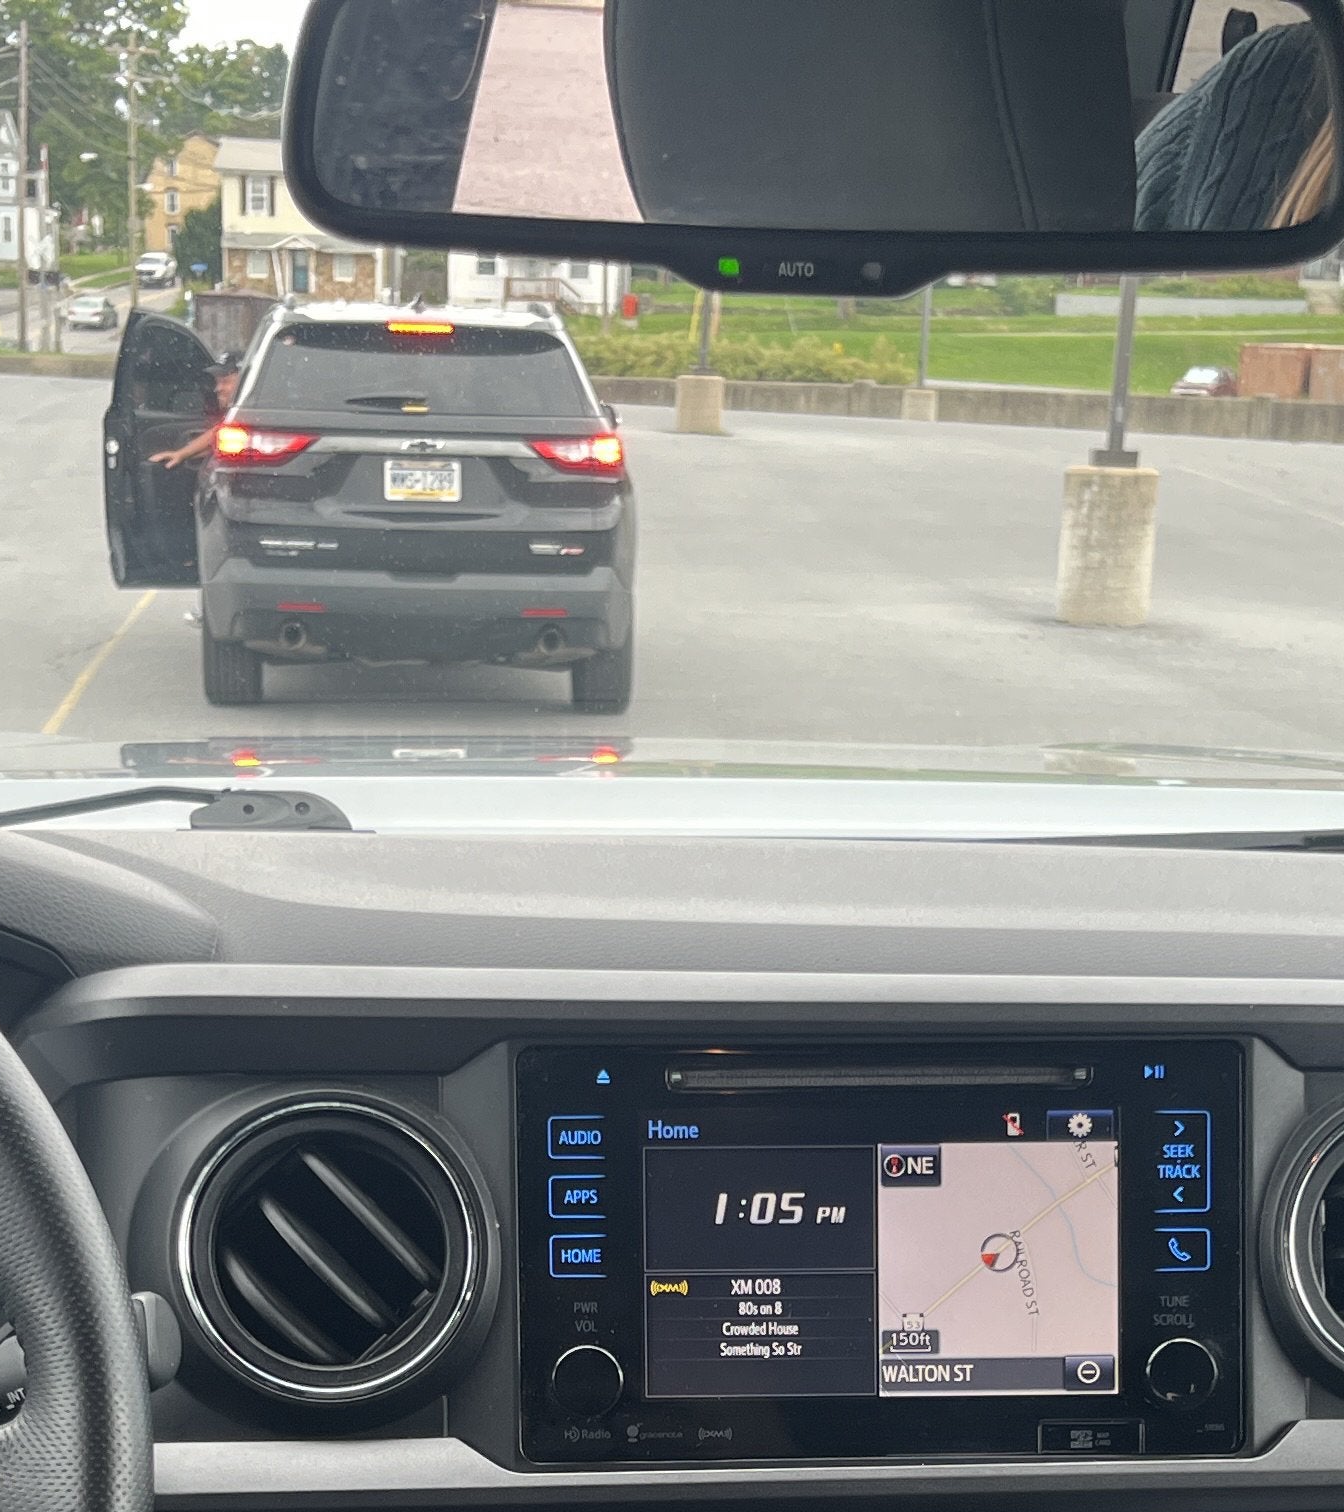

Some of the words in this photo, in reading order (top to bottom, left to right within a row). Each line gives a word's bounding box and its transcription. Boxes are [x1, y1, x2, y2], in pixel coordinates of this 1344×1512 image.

[778, 262, 814, 277] AUTO
[558, 1130, 602, 1145] AUDIO
[648, 1120, 700, 1140] Home
[1162, 1144, 1194, 1158] SEEK
[907, 1157, 934, 1174] NE
[1157, 1164, 1201, 1179] TRACK
[563, 1189, 598, 1204] APPS
[715, 1192, 806, 1225] 1:05
[815, 1206, 846, 1224] PM
[561, 1249, 602, 1264] HOME
[730, 1279, 753, 1295] XM
[755, 1278, 782, 1295] 008
[573, 1302, 598, 1313] PWR
[738, 1301, 757, 1315] 80s
[760, 1305, 772, 1315] on
[774, 1301, 782, 1315] 8
[1159, 1296, 1190, 1307] TUNE
[574, 1320, 598, 1333] VOL
[1153, 1314, 1194, 1326] SCROLL
[722, 1322, 766, 1336] Crowded
[768, 1322, 799, 1336] House
[891, 1332, 931, 1346] 150ft
[719, 1342, 770, 1358] Something
[772, 1342, 785, 1356] So
[787, 1342, 802, 1356] Str
[882, 1364, 950, 1382] WALTON
[953, 1364, 974, 1382] ST
[582, 1429, 611, 1439] Radio
